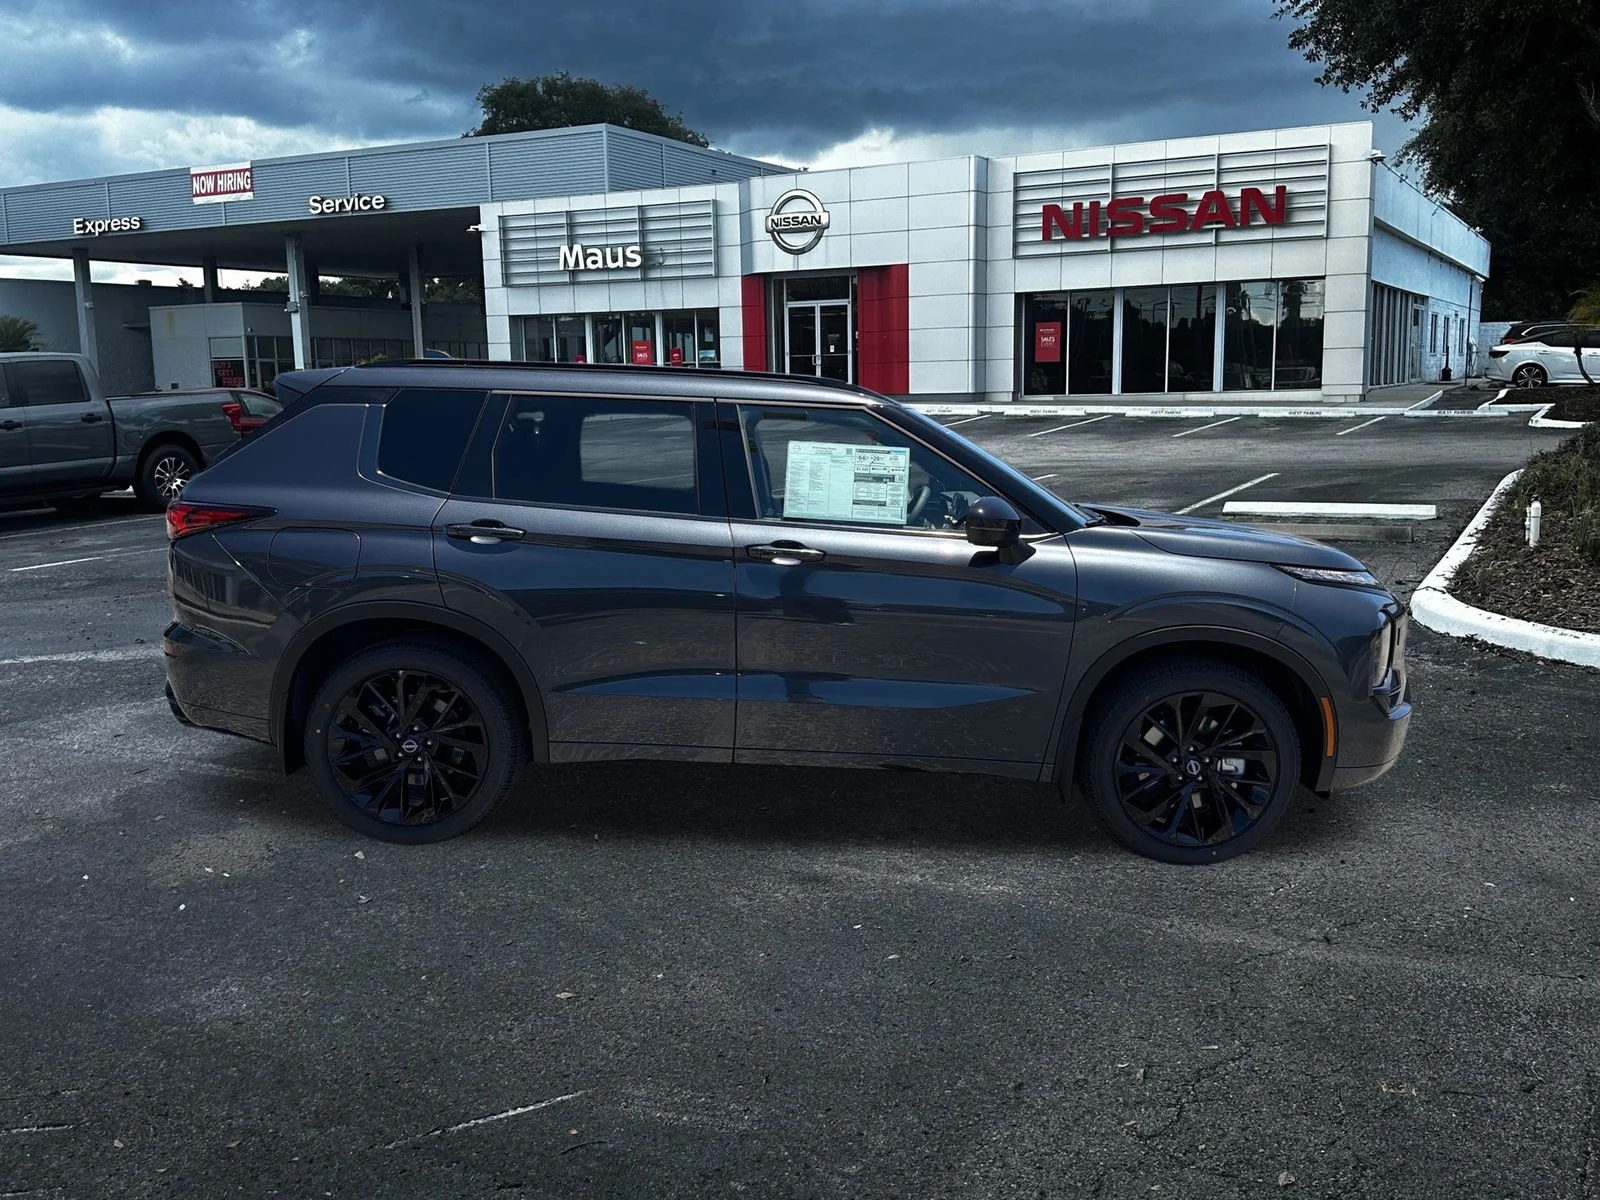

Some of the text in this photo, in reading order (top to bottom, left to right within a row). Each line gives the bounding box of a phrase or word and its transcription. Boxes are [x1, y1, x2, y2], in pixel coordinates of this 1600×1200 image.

[193, 171, 251, 194] NOW HIRING
[309, 193, 385, 214] Service
[1042, 186, 1287, 241] NISSAN
[73, 216, 141, 236] Express
[770, 214, 822, 230] NISSAN
[559, 243, 642, 271] Maus
[223, 377, 244, 387] FREE
